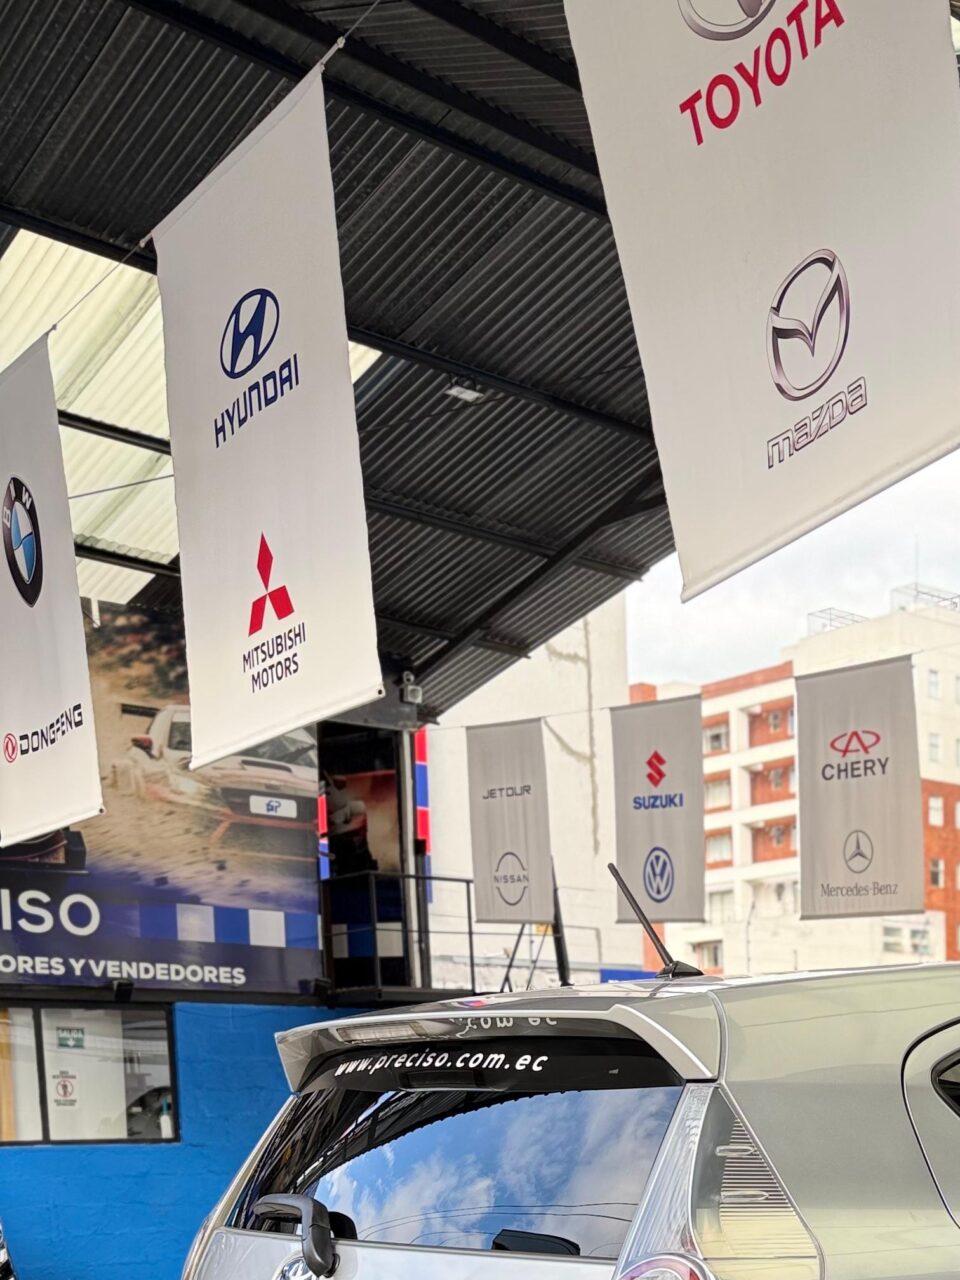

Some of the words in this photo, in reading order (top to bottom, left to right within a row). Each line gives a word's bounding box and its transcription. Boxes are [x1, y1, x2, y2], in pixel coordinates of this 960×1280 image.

[679, 0, 846, 146] TOYOTA
[214, 353, 300, 448] HYUNDAI
[242, 622, 306, 673] MITSUBISHI
[251, 653, 300, 694] MOTORS
[19, 703, 83, 756] DONGFENG
[821, 757, 889, 781] CHERY
[482, 785, 531, 800] JETOUR
[633, 793, 683, 810] SUZUKI
[493, 874, 529, 884] NISSAN
[820, 882, 899, 898] Mercedes-Benz
[0, 888, 100, 937] ISO
[0, 954, 66, 976] ORES
[69, 958, 87, 977] Y
[87, 959, 246, 985] VENDEDORES
[334, 1048, 549, 1078] www.preciso.com.ec
